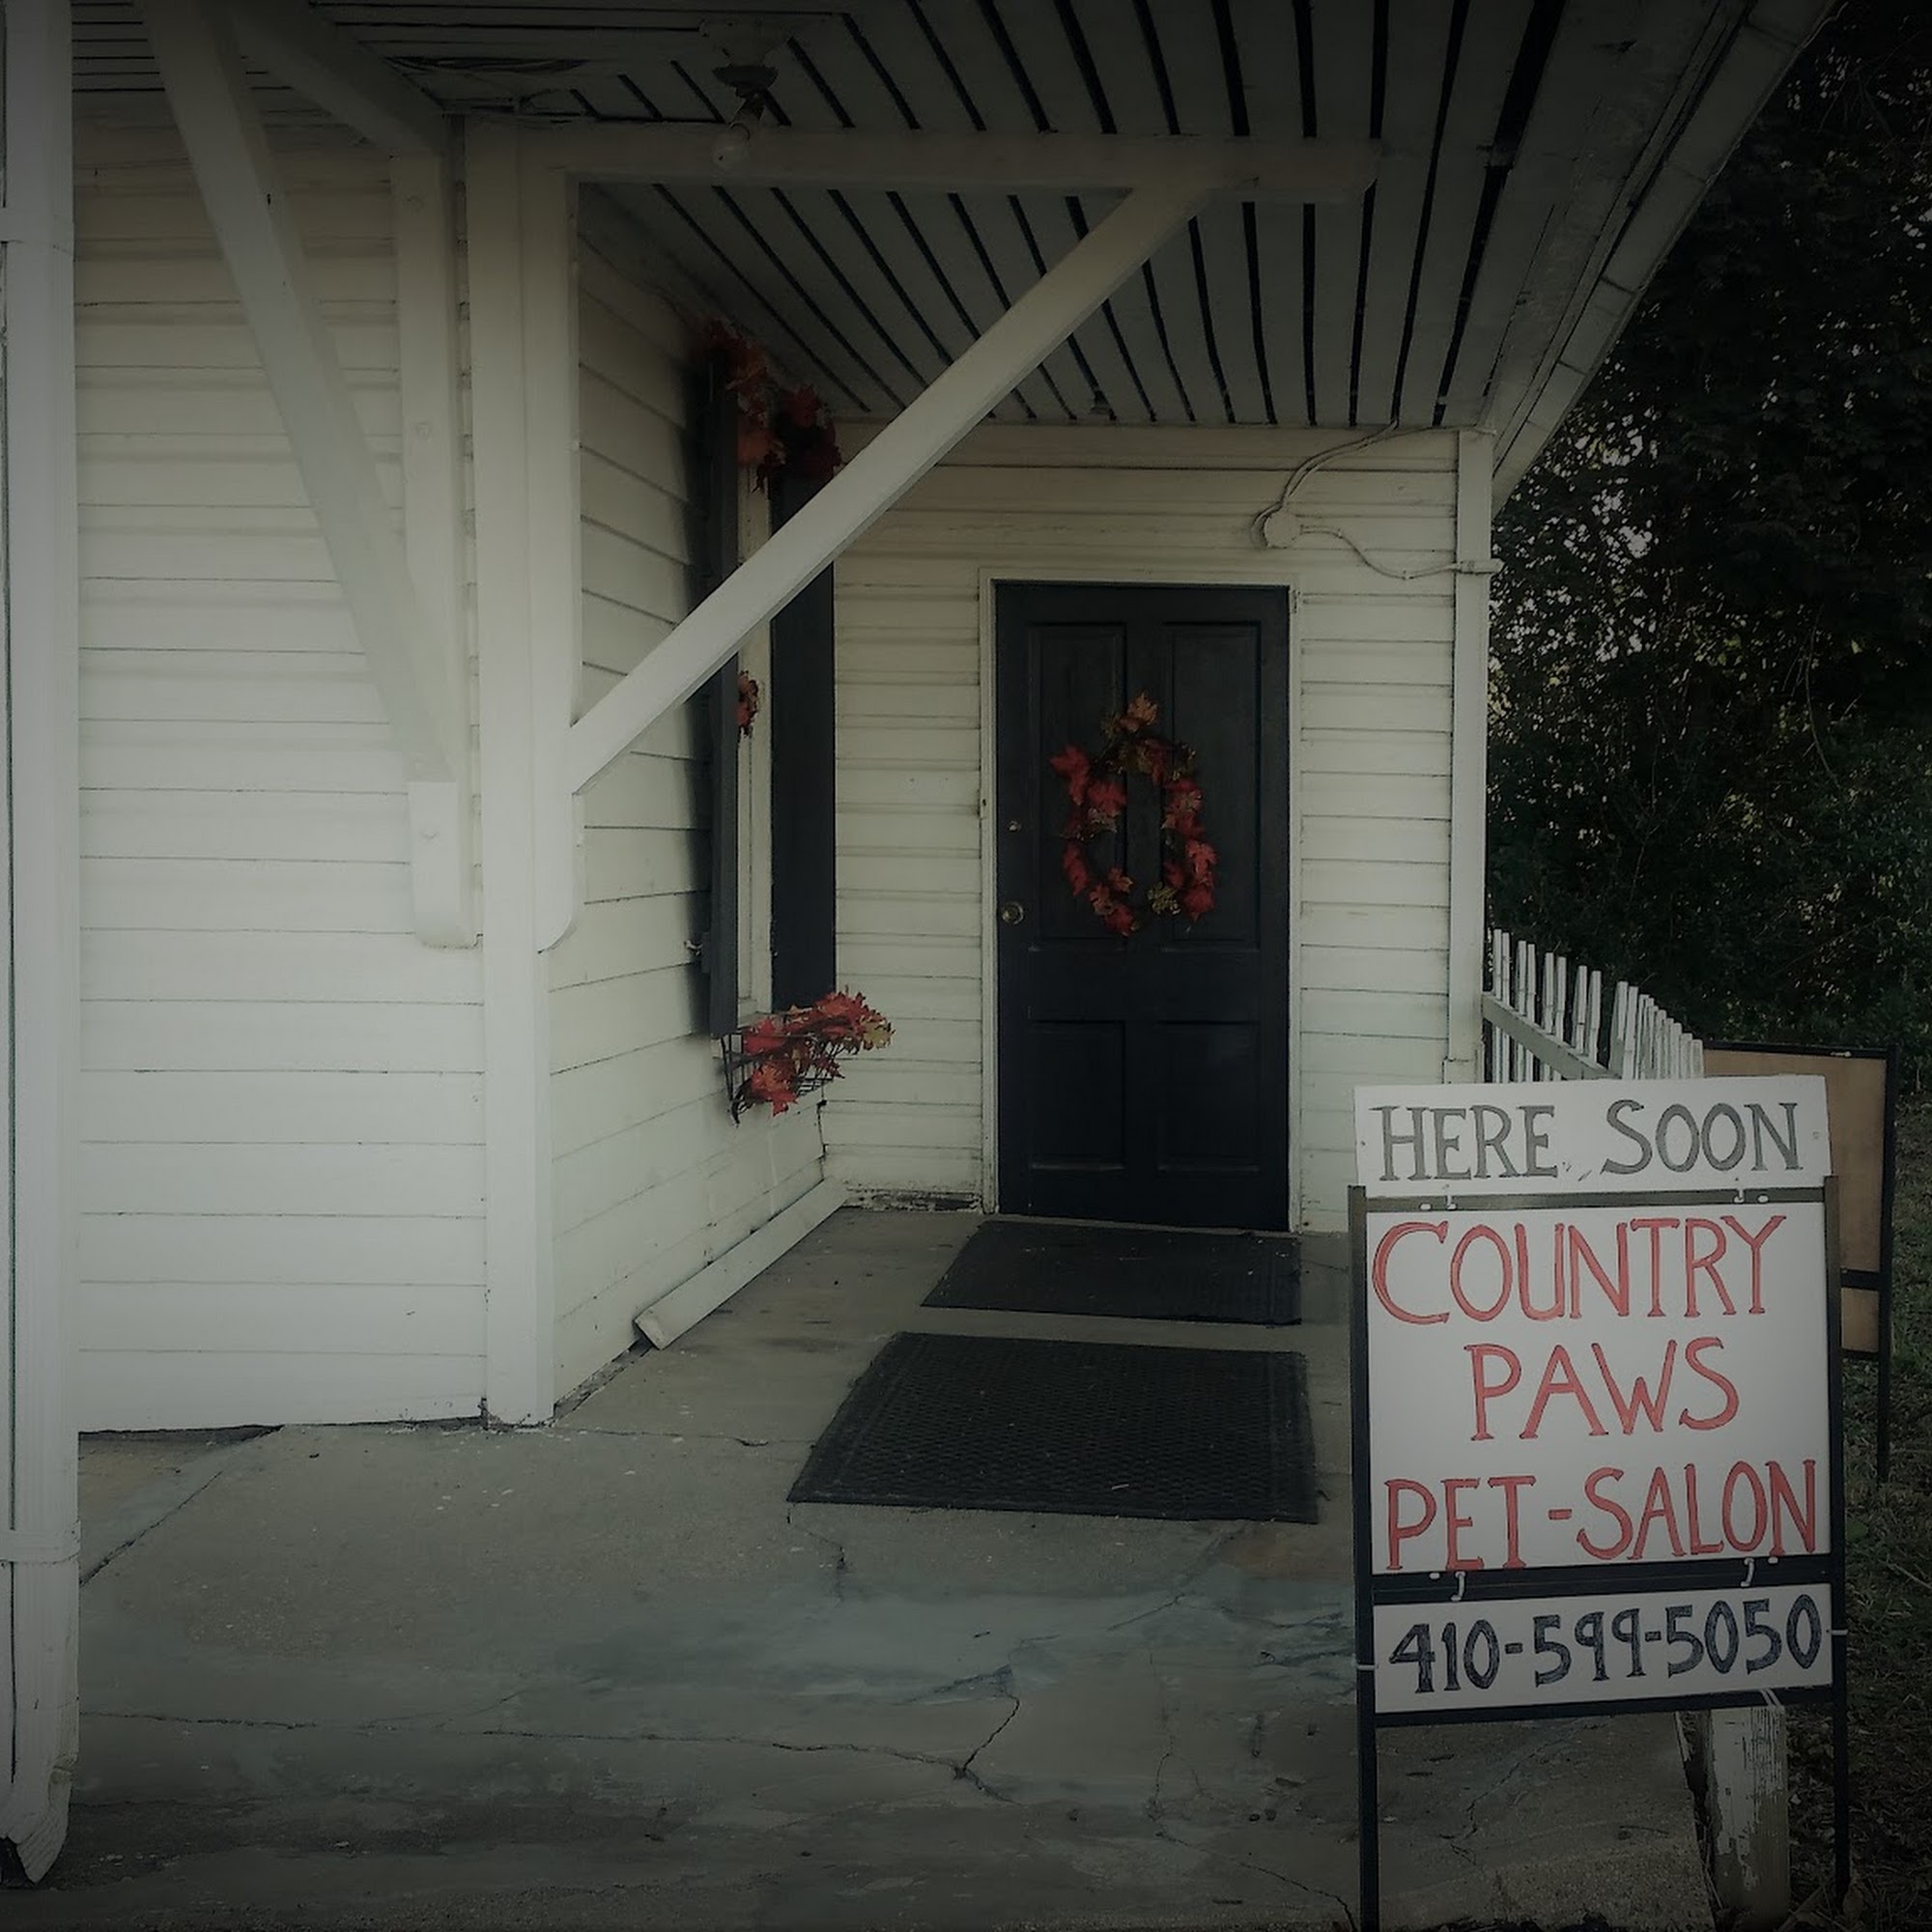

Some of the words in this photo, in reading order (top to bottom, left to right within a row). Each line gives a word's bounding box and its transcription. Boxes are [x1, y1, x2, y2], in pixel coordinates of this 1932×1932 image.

[1369, 1104, 1558, 1180] HERE
[1600, 1099, 1804, 1175] SOON
[1372, 1215, 1786, 1324] COUNTRY
[1463, 1337, 1739, 1440] PAWS
[1383, 1460, 1816, 1571] PET-SALON
[1388, 1594, 1822, 1693] 410-599-5050
